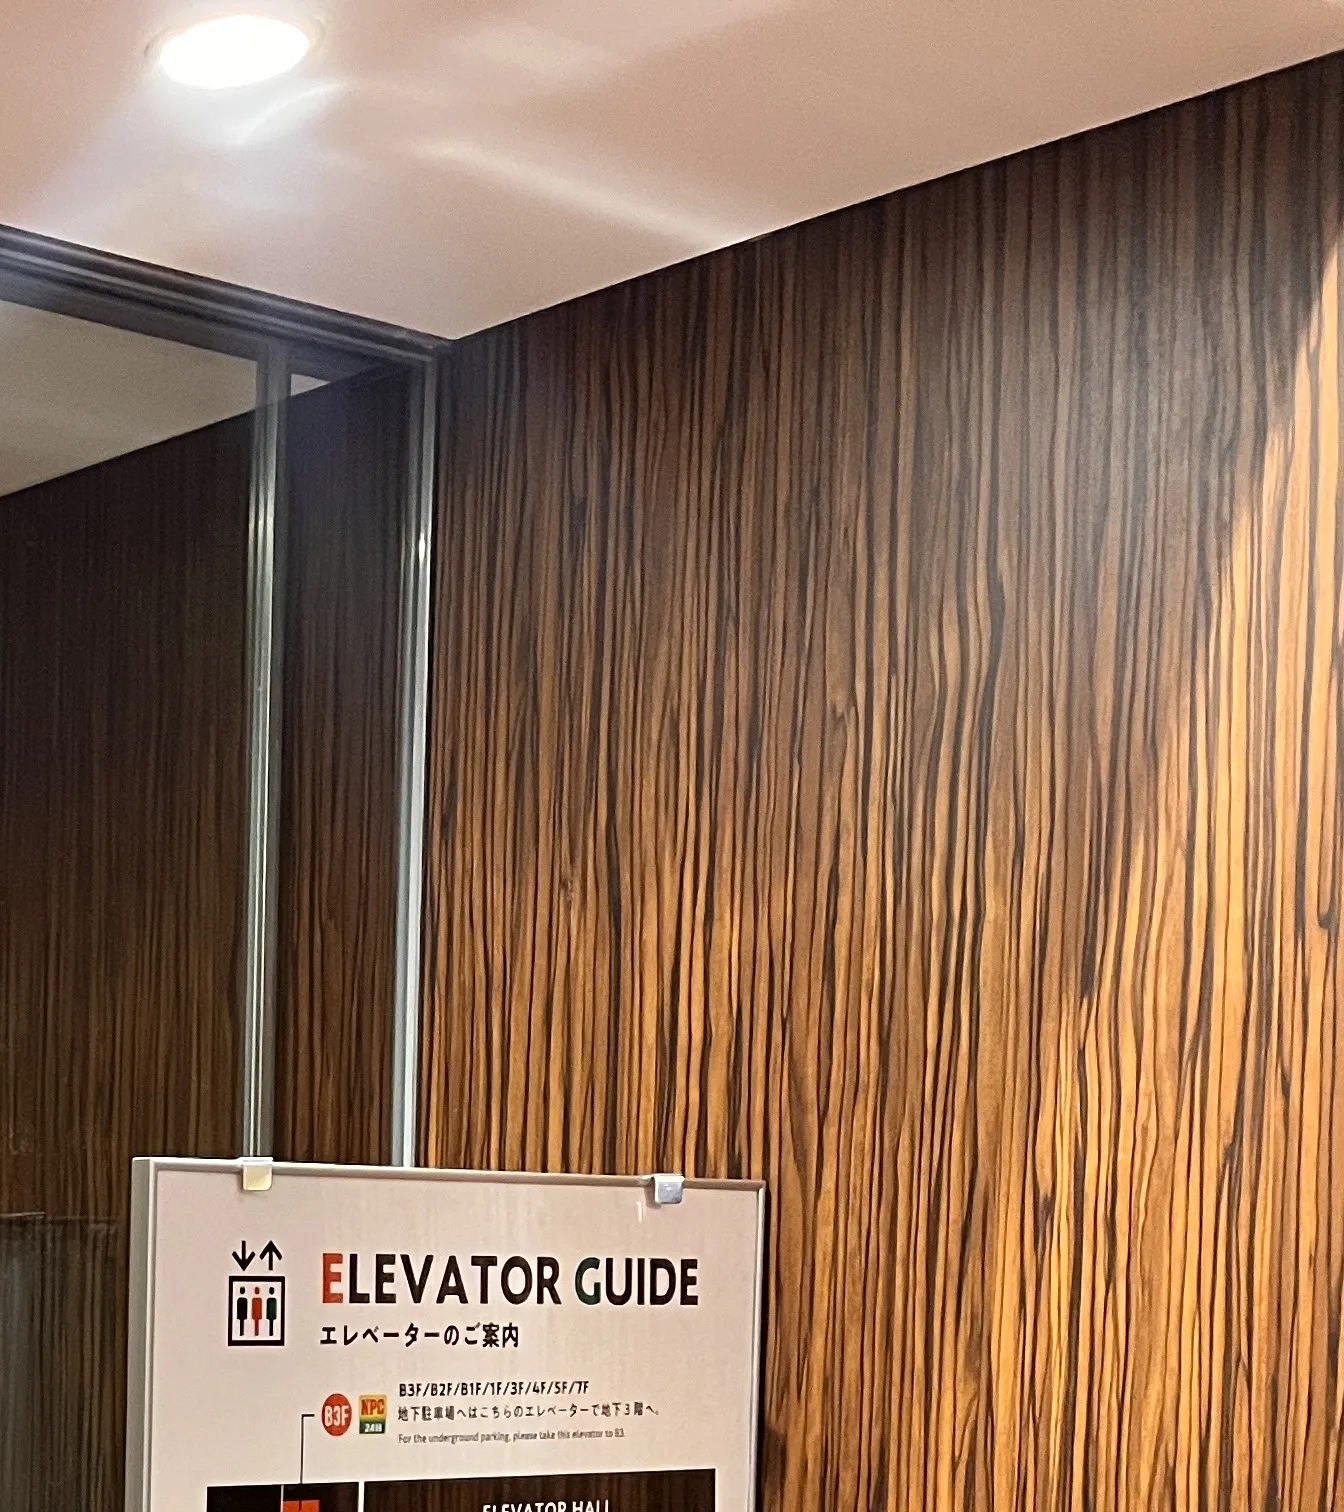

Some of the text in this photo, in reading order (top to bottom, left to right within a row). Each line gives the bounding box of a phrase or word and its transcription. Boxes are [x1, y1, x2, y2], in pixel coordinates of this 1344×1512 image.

[322, 1253, 699, 1306] ELEVATOR GUIDE
[320, 1322, 519, 1348] エレベーターのご案内
[399, 1381, 589, 1398] B3F/B2F/B1F/1F/3F/4F/5F/7F
[324, 1403, 351, 1427] B3F
[361, 1399, 385, 1416] NPC
[364, 1423, 383, 1433] 24H
[398, 1434, 411, 1443] For
[413, 1434, 426, 1443] the
[428, 1432, 479, 1444] underground
[513, 1431, 537, 1442] please
[539, 1430, 555, 1440] take
[558, 1430, 570, 1439] this
[605, 1430, 613, 1438] to
